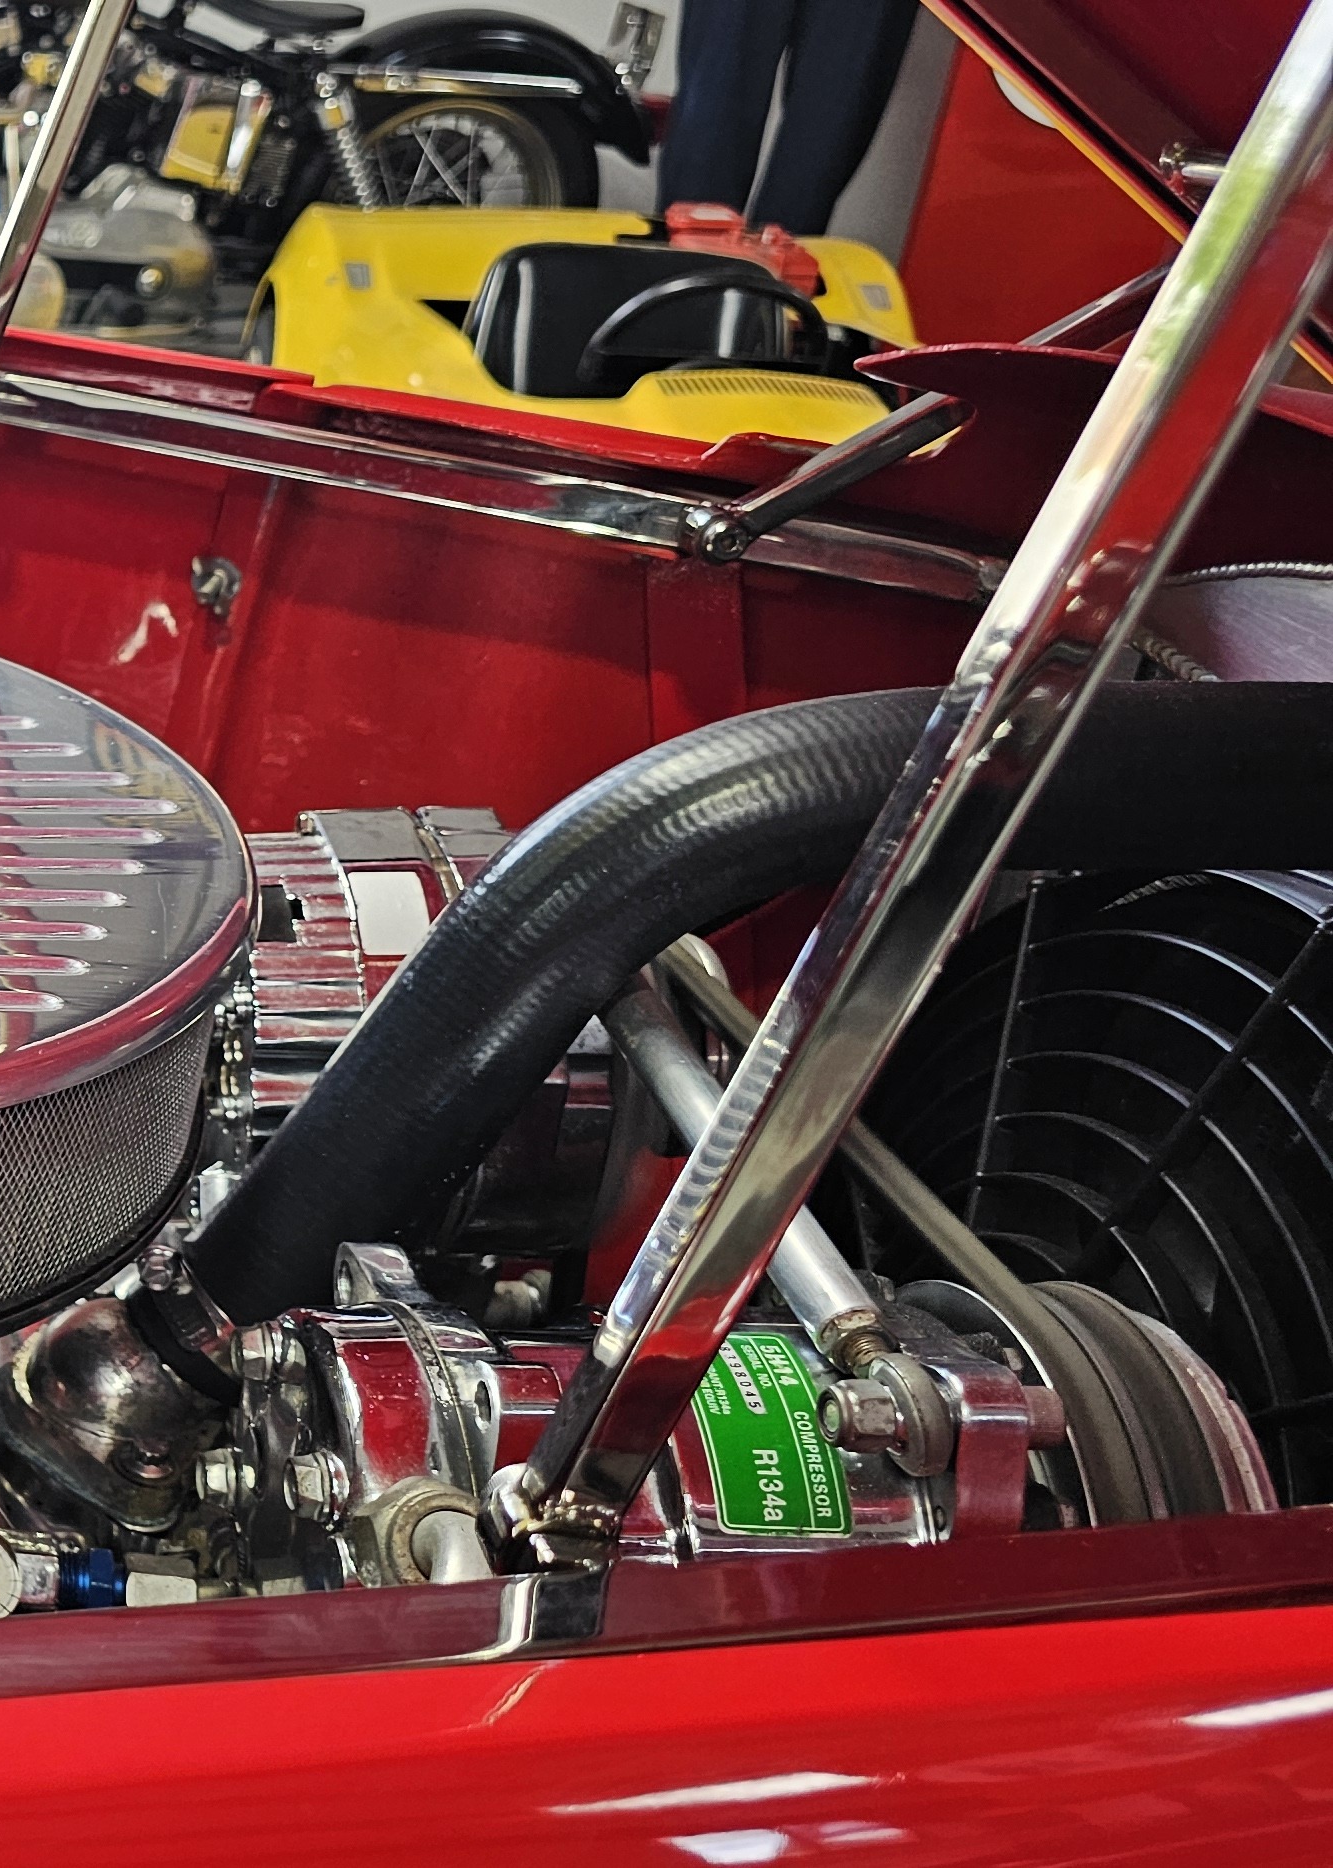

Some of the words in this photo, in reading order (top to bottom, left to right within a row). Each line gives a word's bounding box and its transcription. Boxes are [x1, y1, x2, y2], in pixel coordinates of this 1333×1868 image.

[740, 1344, 764, 1370] SERIAL
[757, 1373, 772, 1389] NO.
[702, 1388, 722, 1415] EQUIV
[752, 1449, 788, 1522] R134a
[793, 1411, 832, 1518] COMPRESSOR
